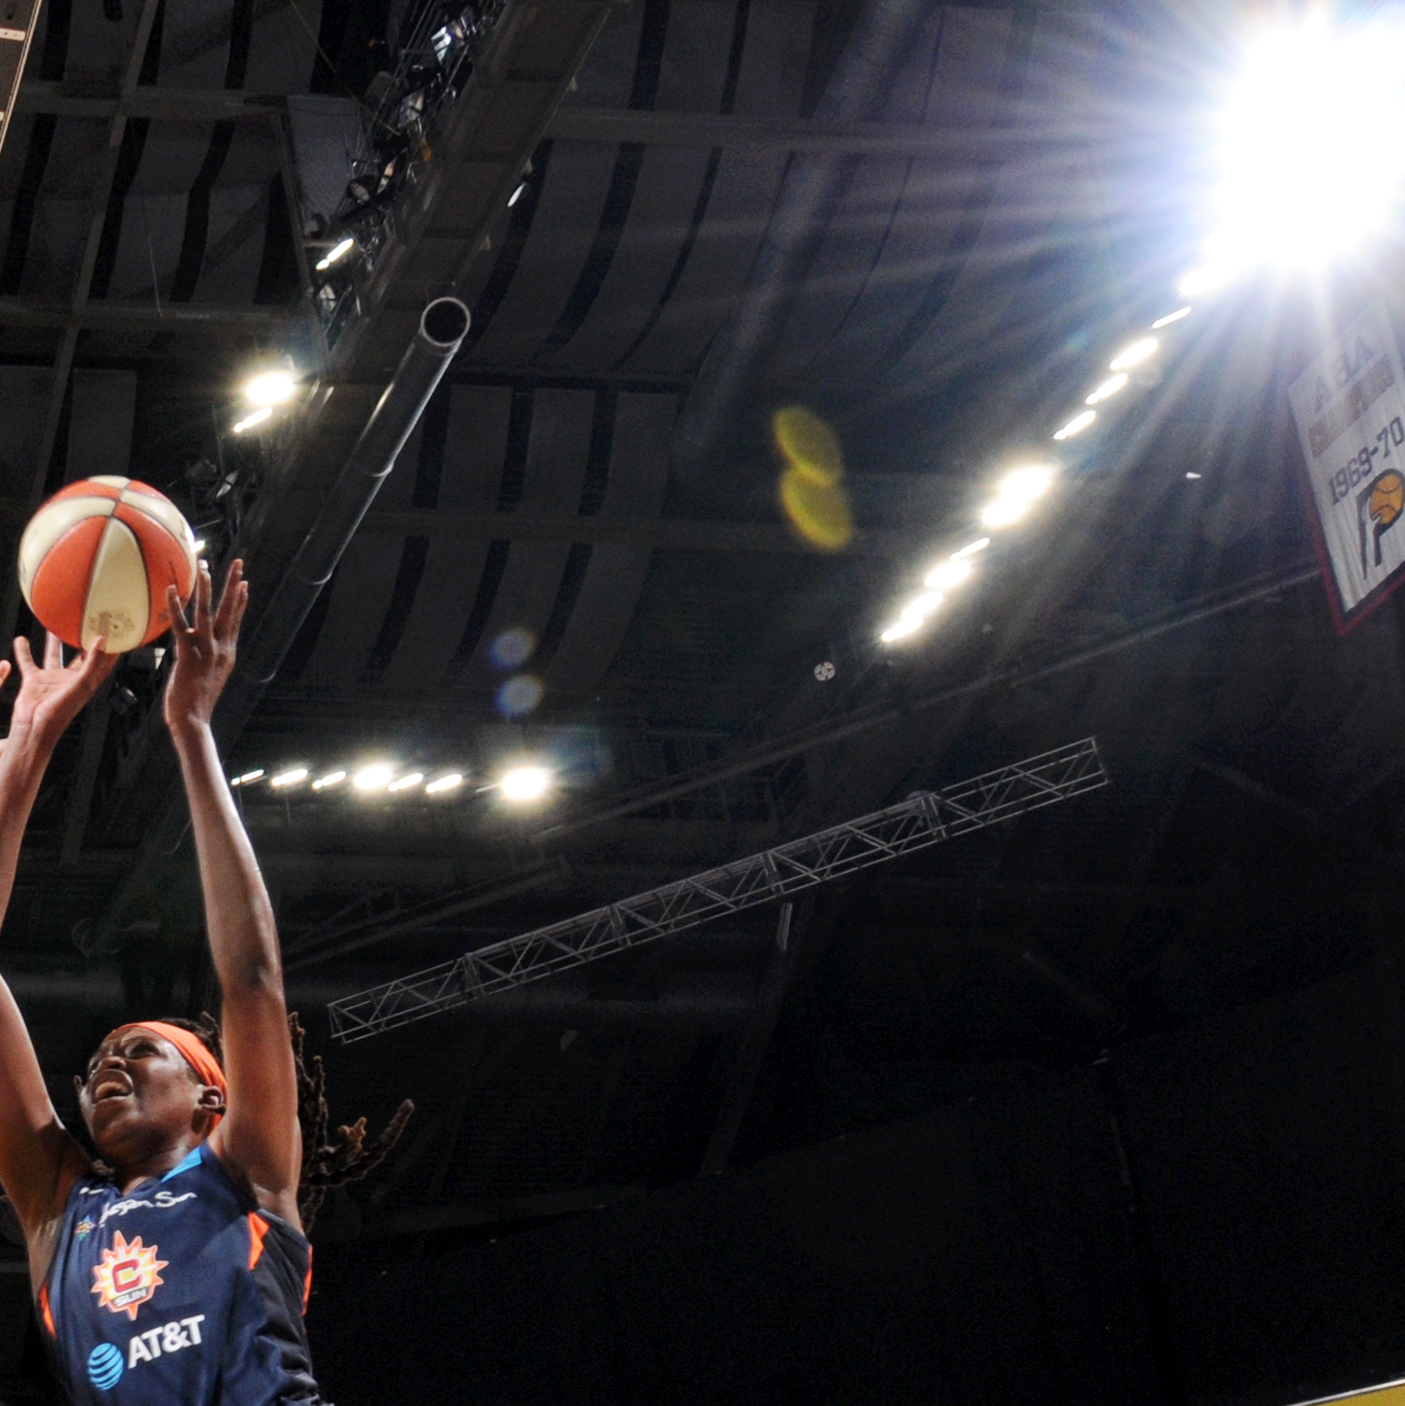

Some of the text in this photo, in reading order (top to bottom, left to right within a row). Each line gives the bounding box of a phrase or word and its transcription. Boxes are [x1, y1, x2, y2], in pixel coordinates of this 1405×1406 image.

[1329, 416, 1405, 505] 1969-70
[112, 1259, 140, 1293] C
[114, 1288, 147, 1307] SUN
[128, 1314, 205, 1369] AT&T
